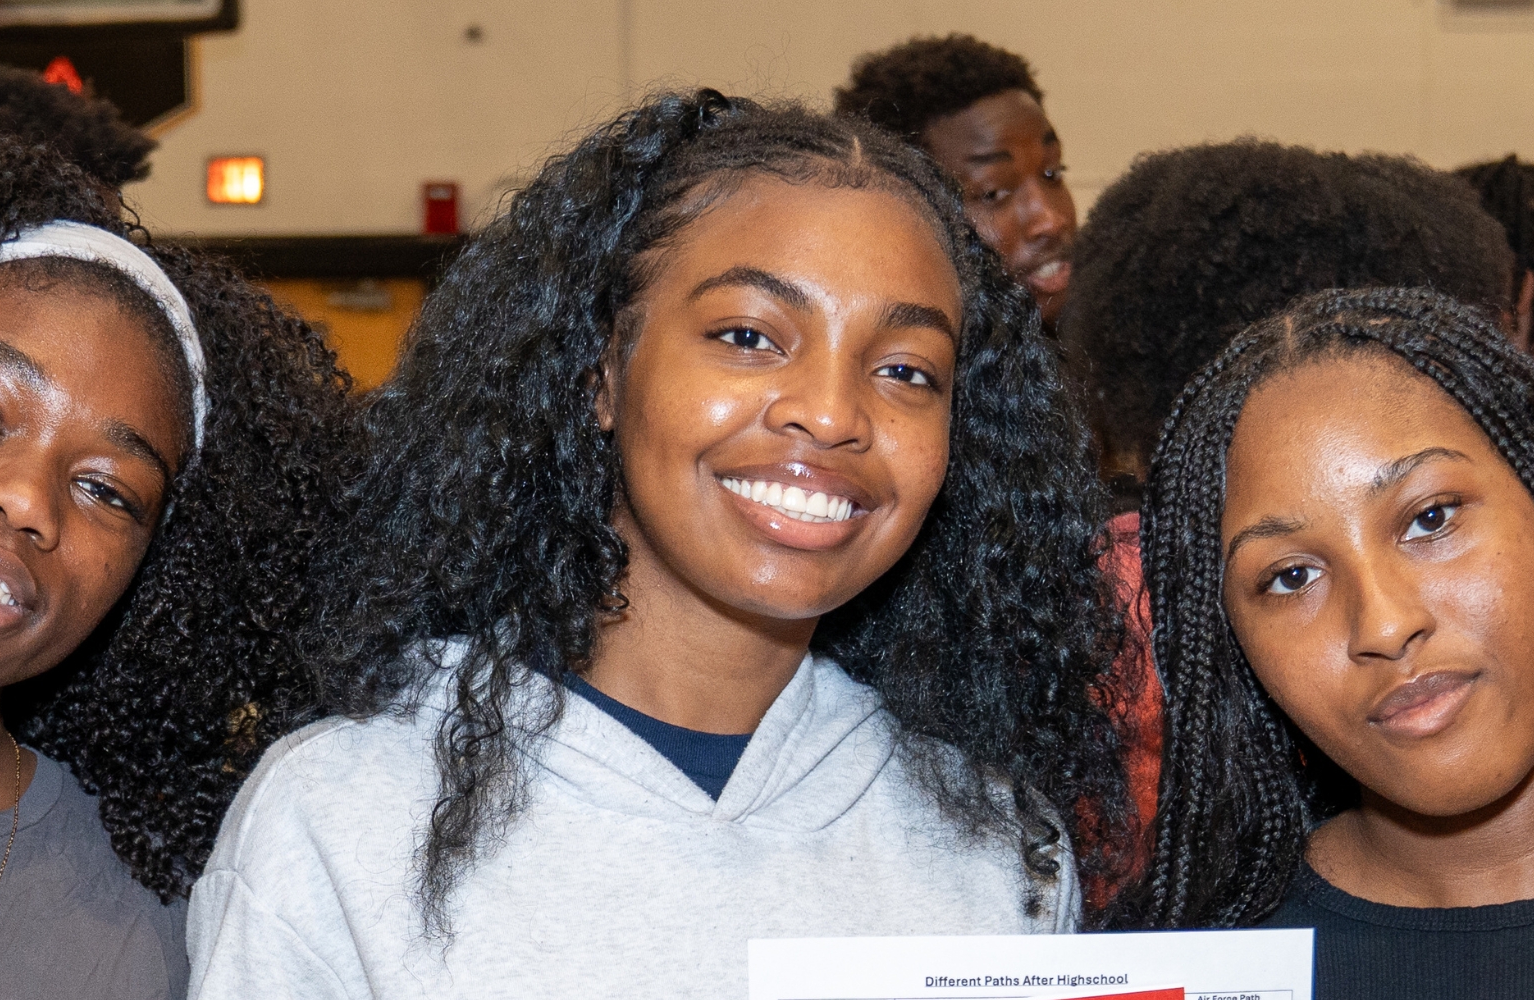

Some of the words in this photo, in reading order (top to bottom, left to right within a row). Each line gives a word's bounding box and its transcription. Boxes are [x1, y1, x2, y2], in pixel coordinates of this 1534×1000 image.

[925, 976, 982, 987] Different
[985, 975, 1020, 987] Paths
[1022, 975, 1054, 986] After
[1057, 973, 1129, 987] Highschool
